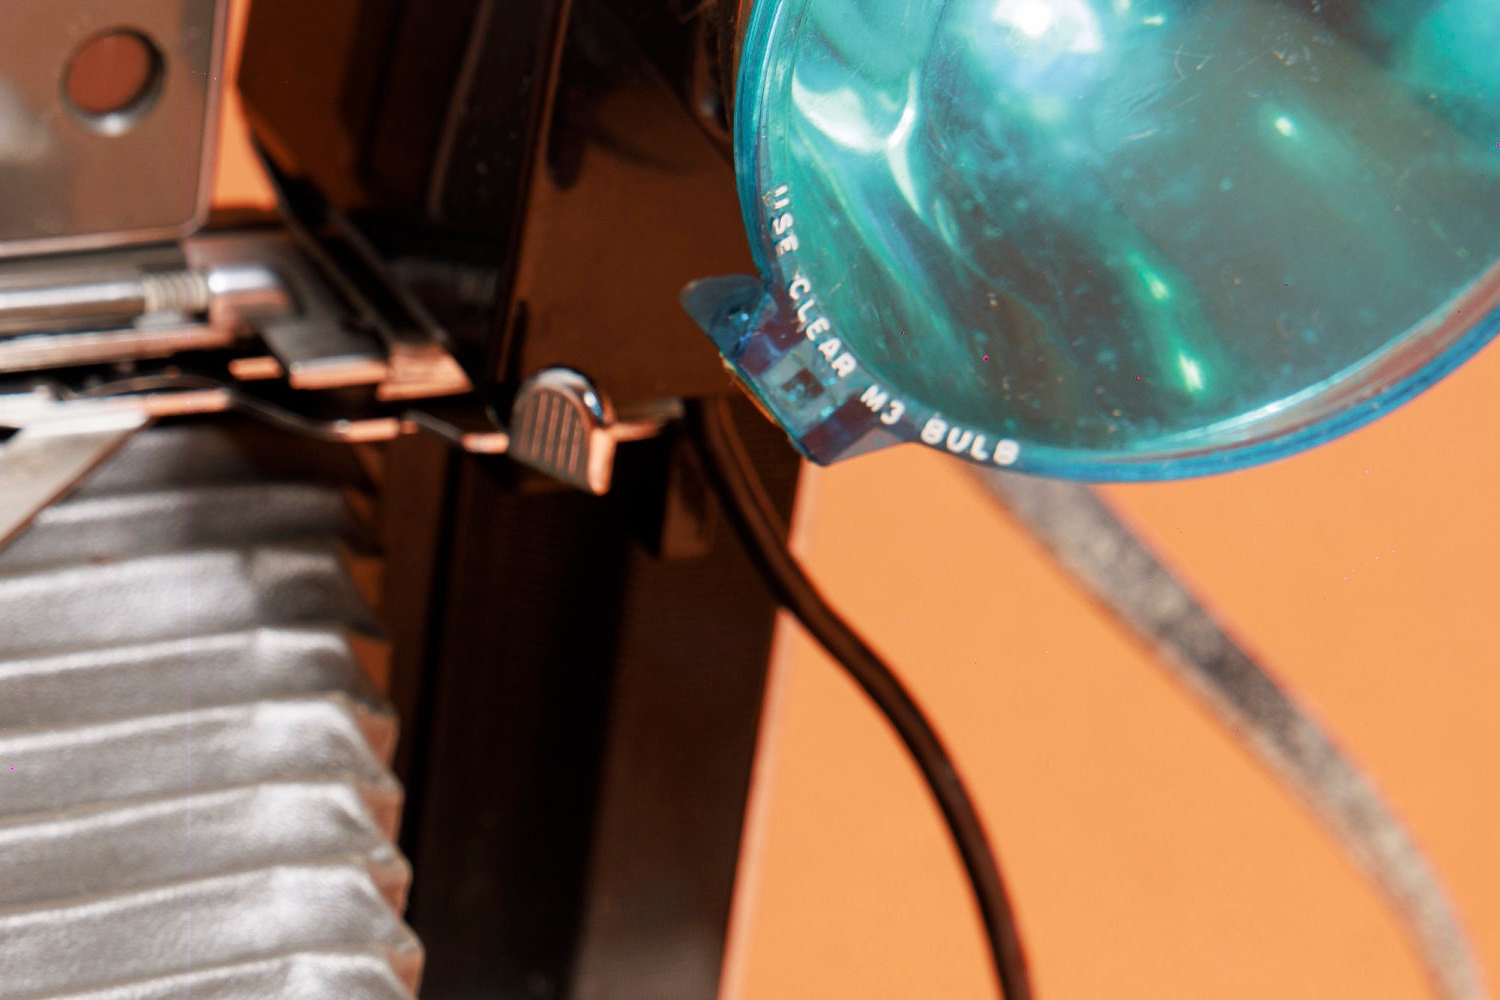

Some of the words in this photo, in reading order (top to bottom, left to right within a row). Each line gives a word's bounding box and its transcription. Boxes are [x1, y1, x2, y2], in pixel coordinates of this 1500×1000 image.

[764, 185, 798, 256] USE
[789, 272, 856, 377] CLEAR
[861, 385, 905, 424] M3
[921, 419, 1019, 464] BULB
